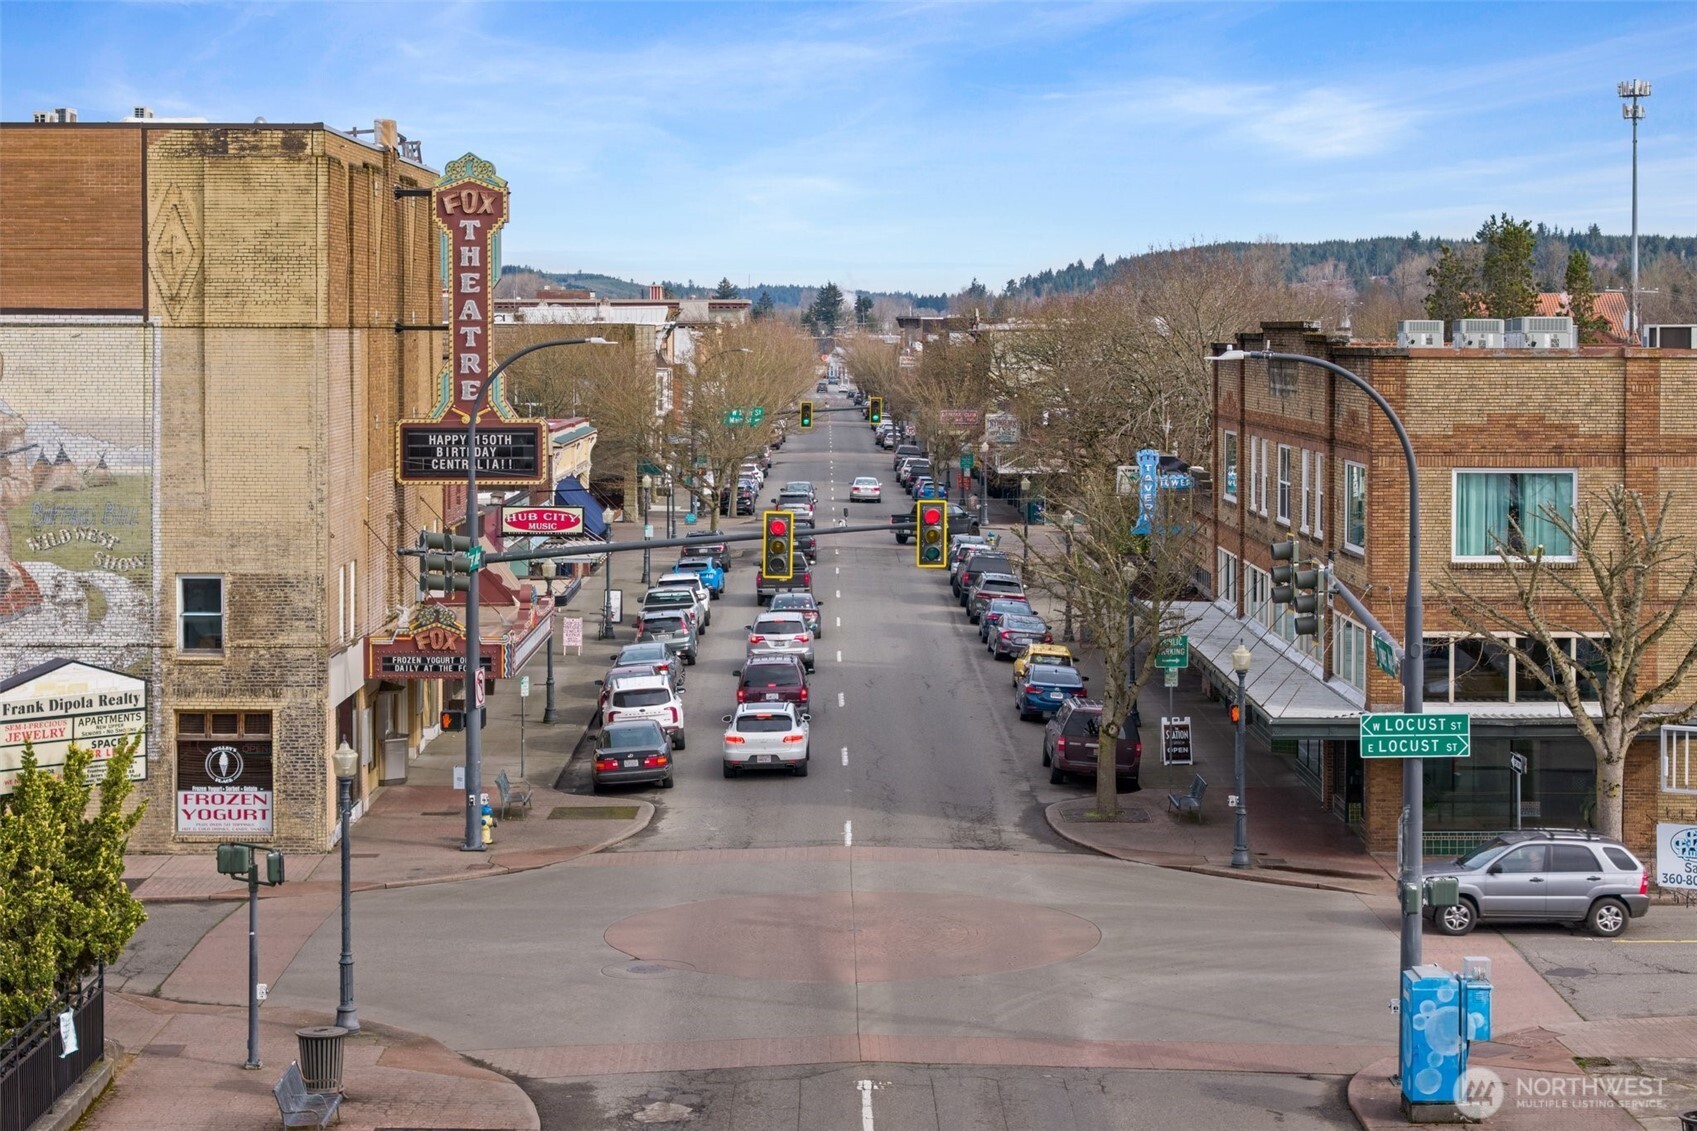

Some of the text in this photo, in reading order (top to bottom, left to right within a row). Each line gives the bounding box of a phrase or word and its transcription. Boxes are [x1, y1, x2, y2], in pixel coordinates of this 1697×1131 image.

[443, 188, 497, 215] FOX
[459, 219, 482, 401] THEATRE
[428, 434, 512, 446] HAPPY 150TH
[431, 458, 513, 471] CENTRLIA!!
[505, 512, 580, 523] HUB CITY
[528, 522, 558, 530] MUSIC
[26, 526, 121, 553] WILD WEST
[92, 551, 147, 572] SHOW
[414, 628, 459, 651] FOX
[1158, 648, 1186, 656] ARKING
[392, 656, 422, 664] FROZEN
[426, 656, 455, 664] YOGURT
[394, 664, 419, 672] DAILY
[423, 664, 434, 672] AT
[438, 664, 453, 672] THE
[2, 692, 140, 716] Frank Dipola Realty
[78, 712, 142, 727] APARTMENTS
[1373, 718, 1462, 732] W LOCUST ST
[5, 727, 66, 743] JEWELRY
[1165, 729, 1189, 740] SATION
[1368, 739, 1458, 753] E LOCUST ST
[183, 793, 267, 806] FROZEN
[181, 808, 270, 821] YOGURT
